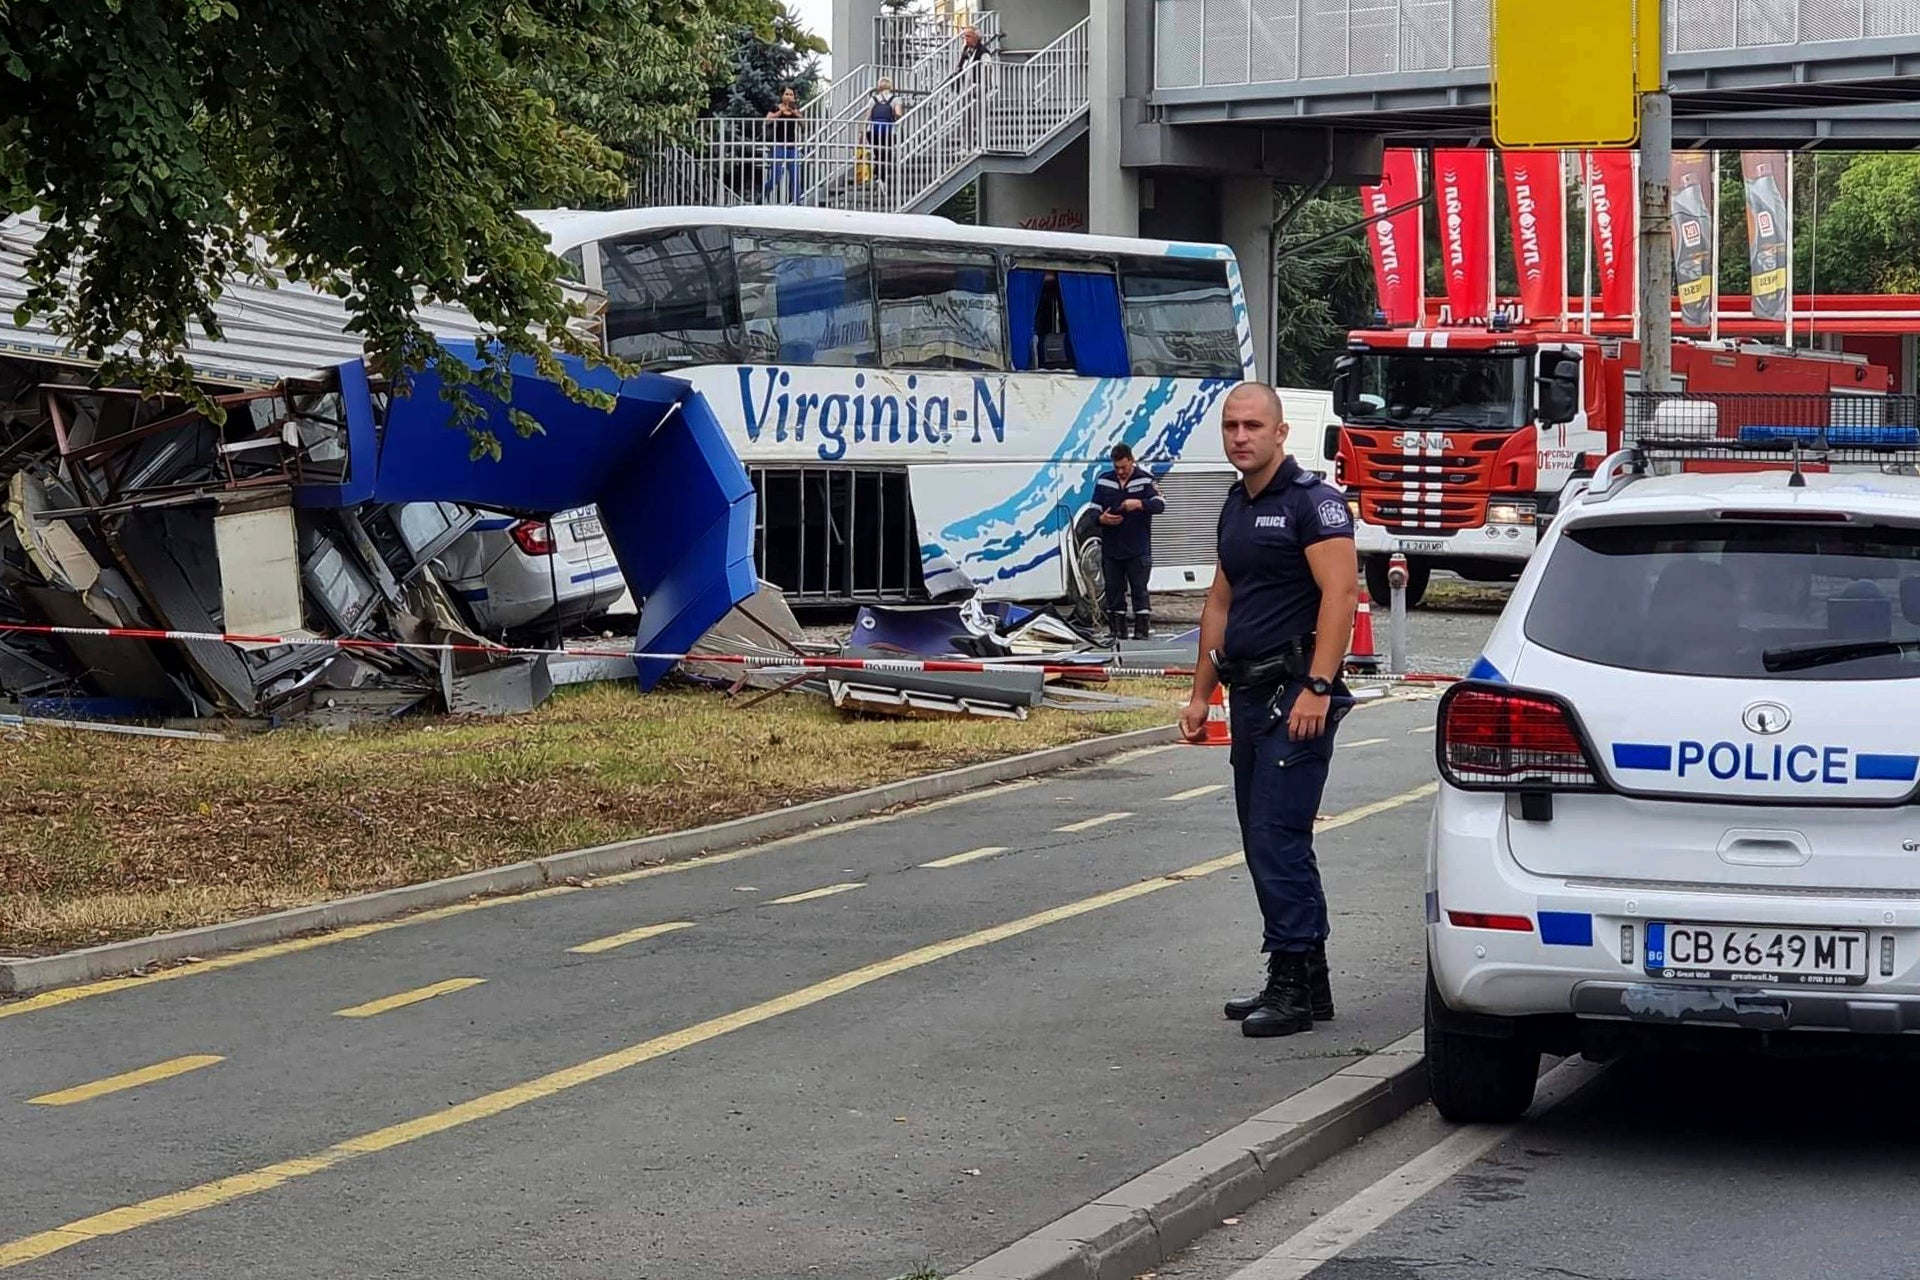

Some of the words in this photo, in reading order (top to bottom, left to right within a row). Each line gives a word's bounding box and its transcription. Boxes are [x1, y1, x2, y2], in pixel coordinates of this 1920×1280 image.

[737, 366, 1007, 461] Virginia-N
[1392, 436, 1454, 450] SCANIA
[1254, 516, 1287, 528] POLICE
[1677, 740, 1849, 784] POLICE
[1648, 951, 1663, 961] BG
[1671, 930, 1714, 964] CB
[1723, 932, 1806, 967] 6649
[1814, 935, 1859, 970] MT
[1676, 971, 1695, 979] Great
[1696, 971, 1711, 979] Wall
